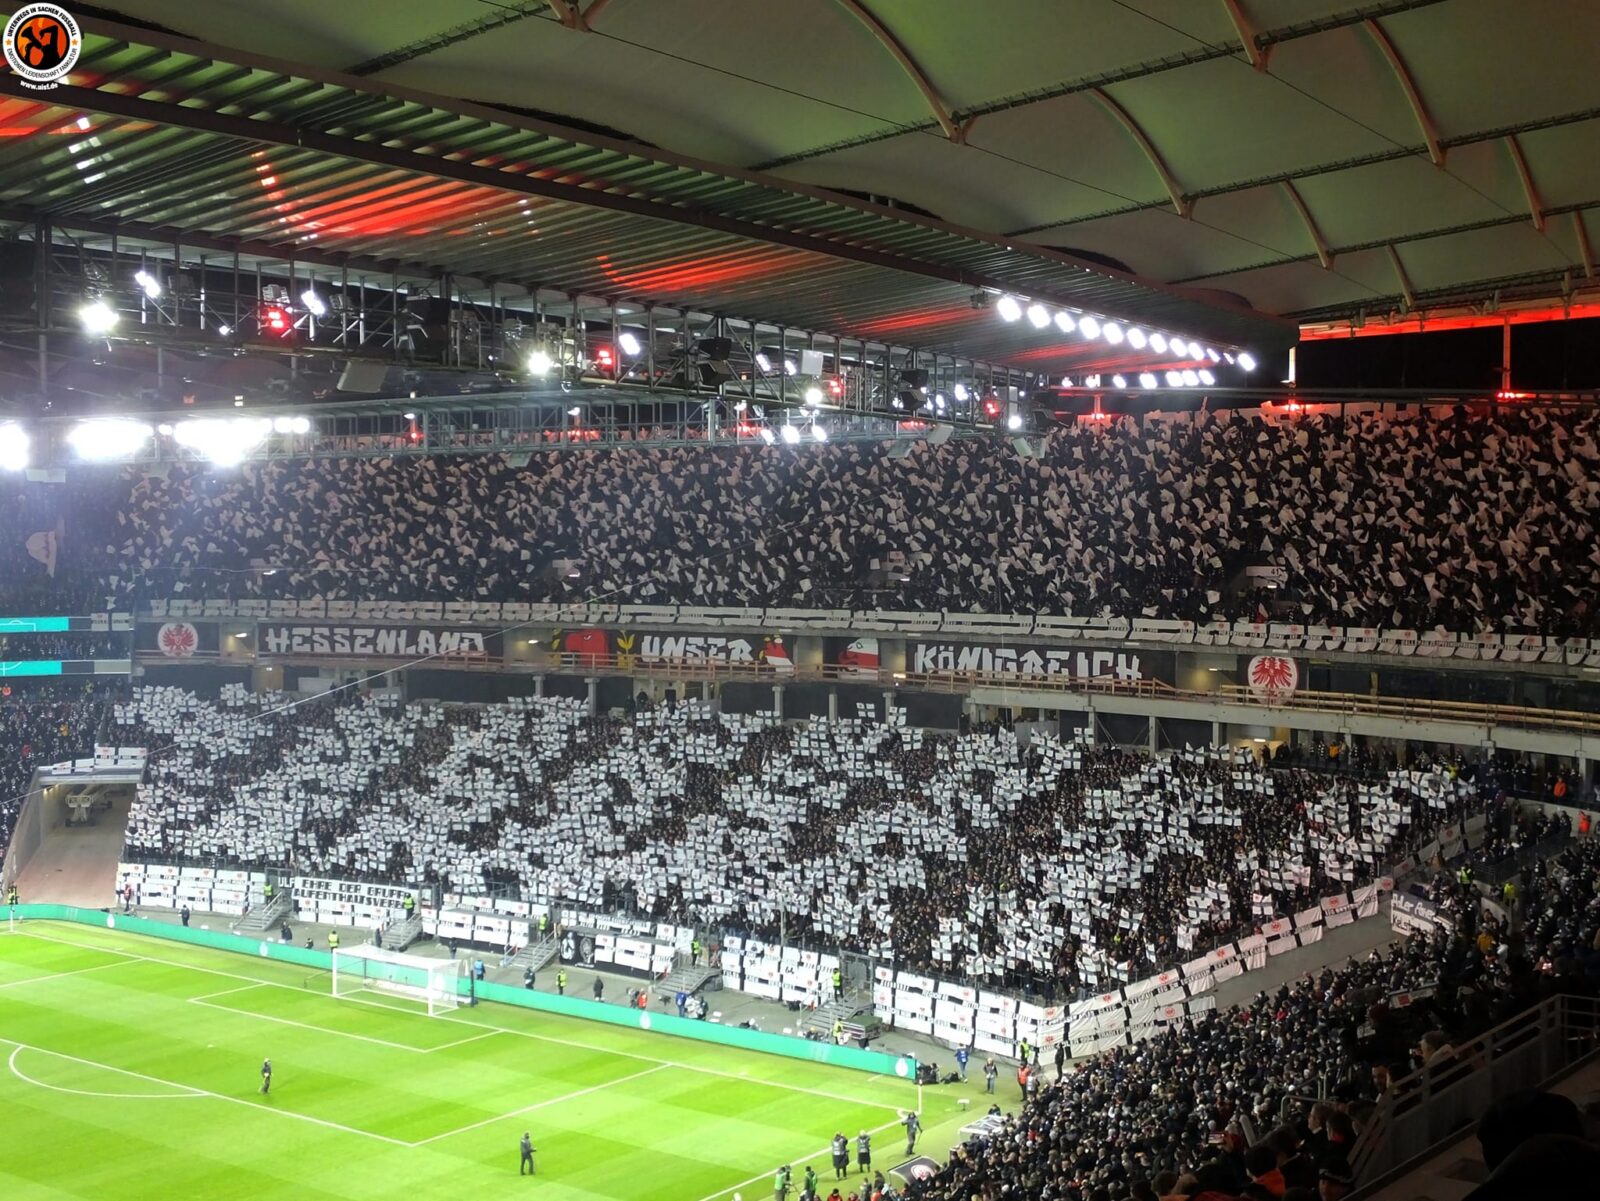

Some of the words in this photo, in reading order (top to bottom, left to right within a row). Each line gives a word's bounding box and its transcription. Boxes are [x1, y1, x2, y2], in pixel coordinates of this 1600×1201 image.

[265, 627, 487, 656] HESSENLAND
[641, 635, 755, 665] UNSER
[914, 643, 1142, 684] KÖNIGREICH
[301, 879, 333, 891] EHRE
[339, 882, 362, 894] DER
